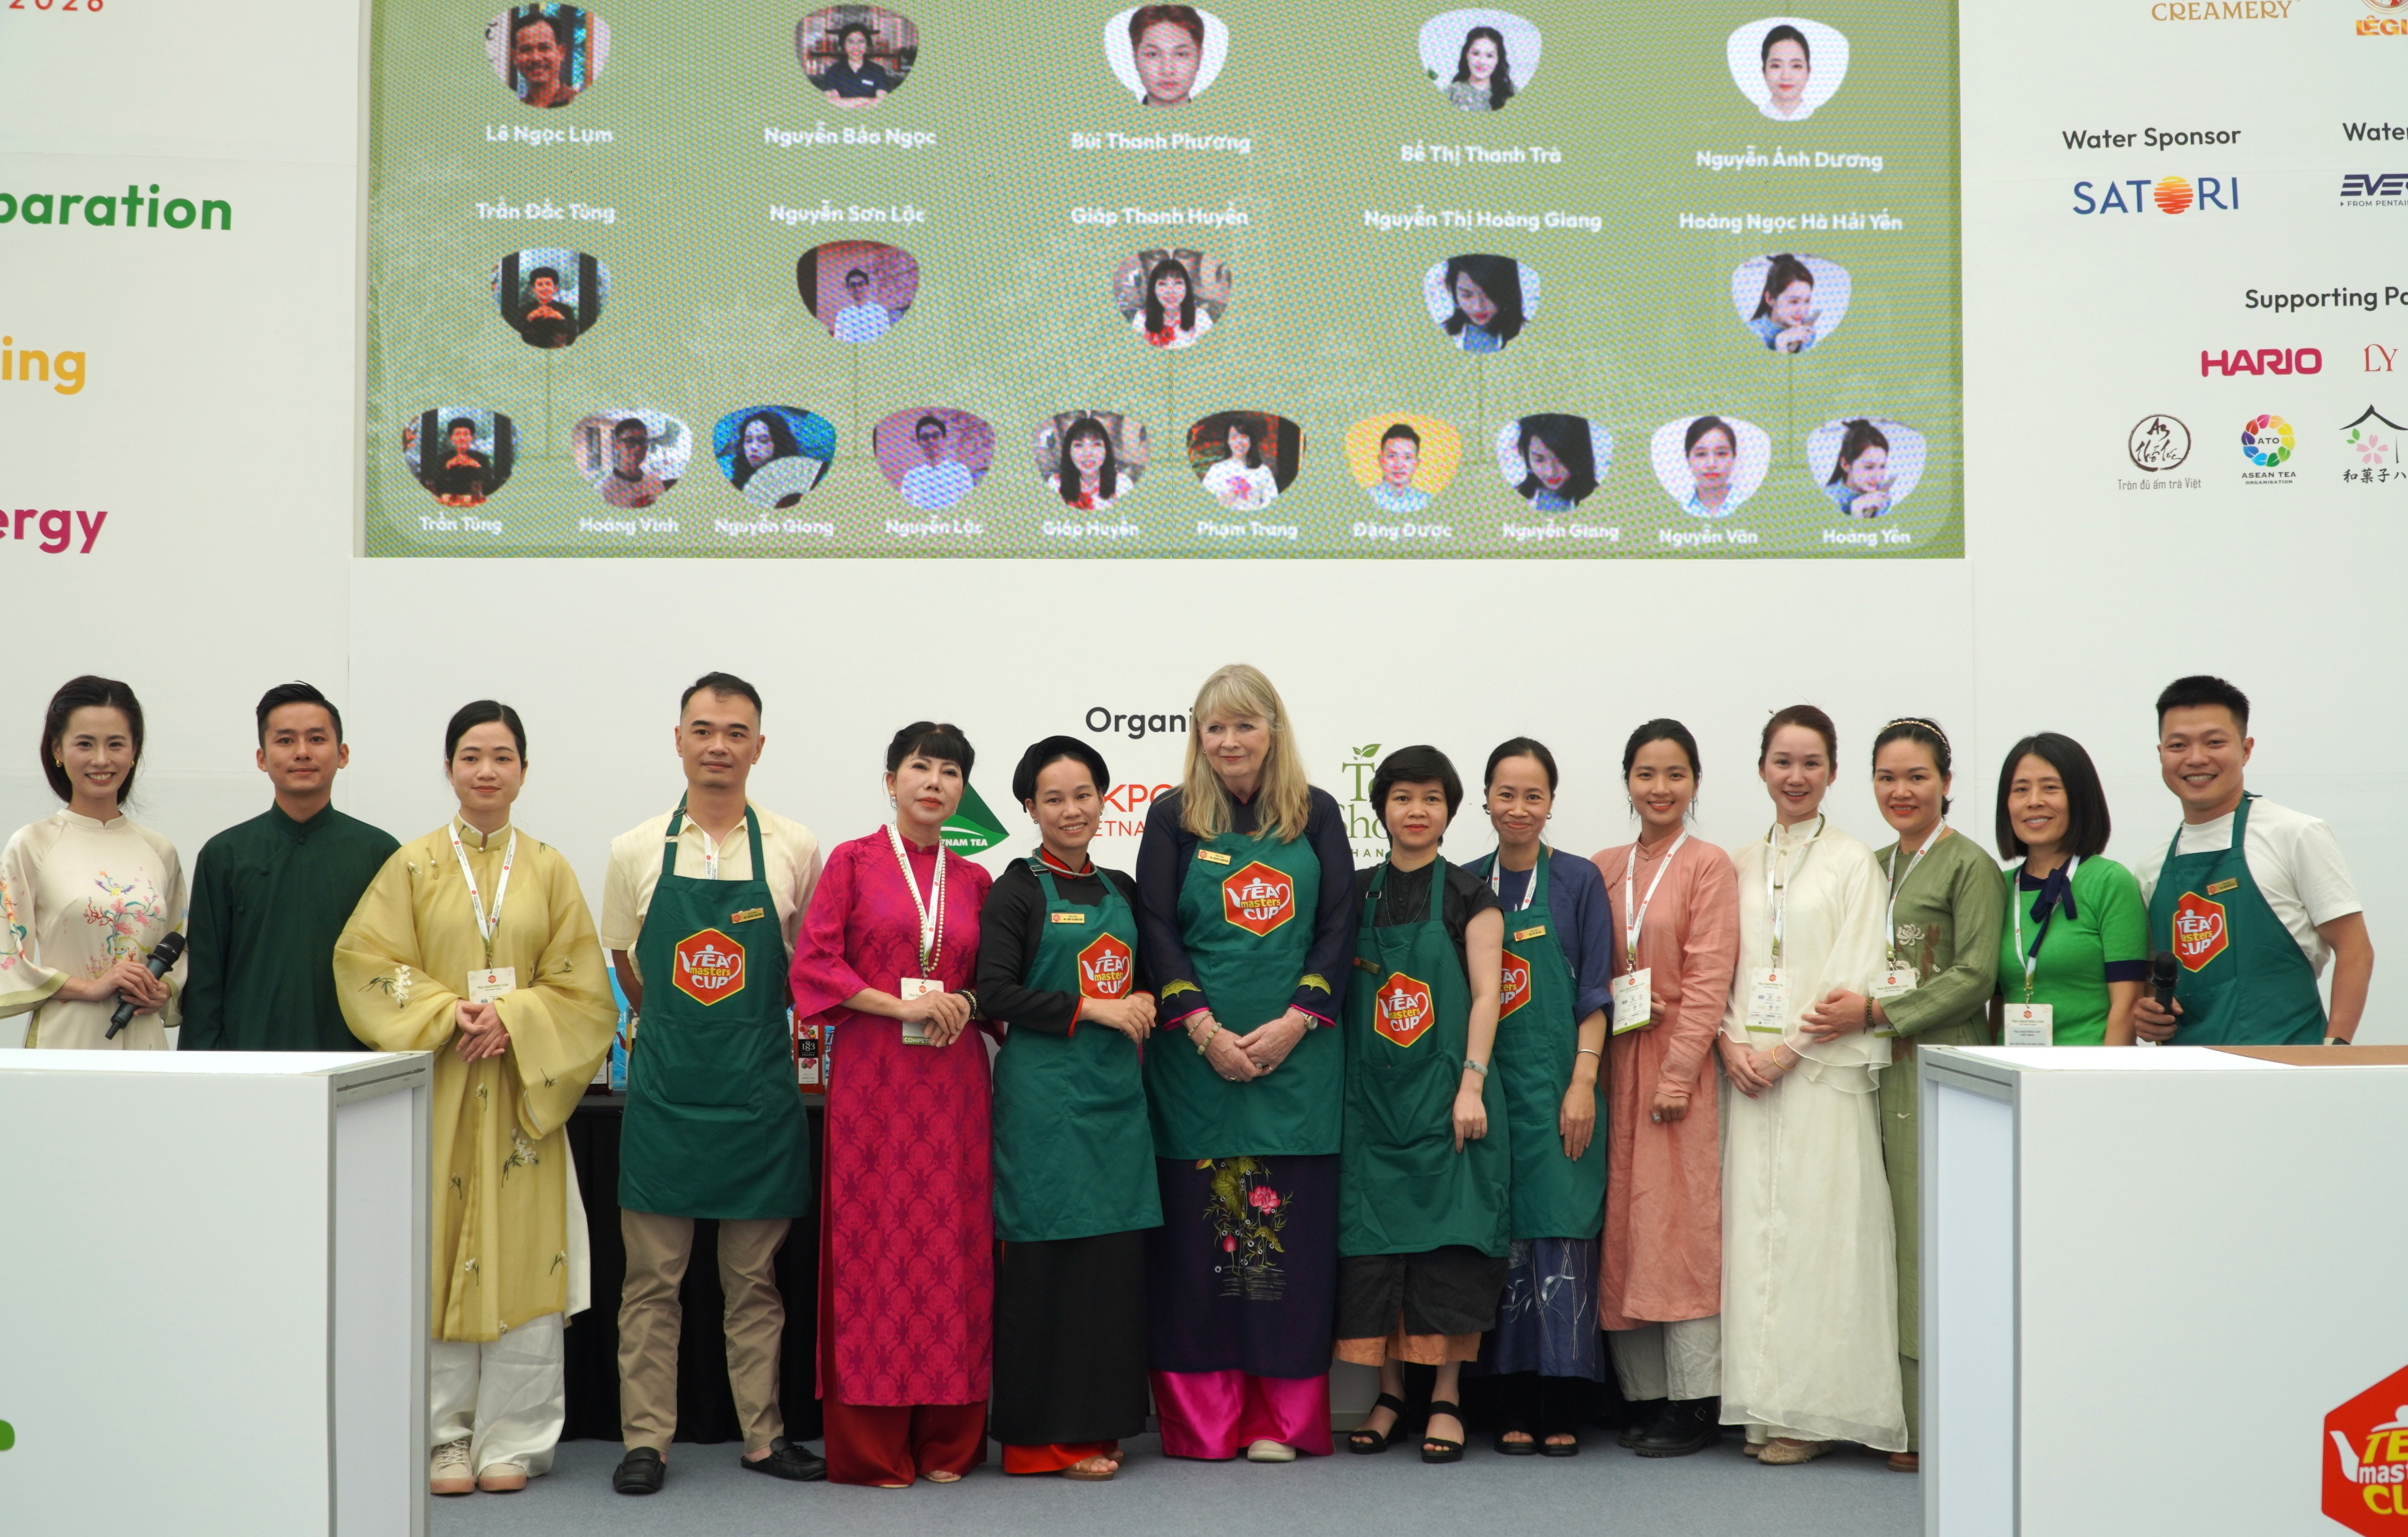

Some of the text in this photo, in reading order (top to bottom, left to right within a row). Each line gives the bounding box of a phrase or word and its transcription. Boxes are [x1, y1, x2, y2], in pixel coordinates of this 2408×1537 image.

[2152, 0, 2292, 21] CREAMERY
[486, 124, 508, 141] Lê
[514, 126, 565, 146] Ngọc
[765, 122, 838, 147] Nguyễn
[885, 127, 936, 148] Ngọc
[2062, 127, 2241, 151] Water Sponsor
[2342, 122, 2408, 141] Wate
[1107, 132, 1167, 150] Thanh
[1172, 133, 1251, 154] Phương
[1430, 146, 1460, 167] Thị
[1465, 146, 1525, 164] Thanh
[1696, 145, 1883, 172] Nguyễn Ánh Dương
[2073, 176, 2239, 215] SATORI
[2340, 174, 2408, 196] EVE
[476, 196, 520, 219] Trần
[569, 203, 616, 224] Tùng
[770, 200, 843, 225] Nguyễn
[1124, 207, 1183, 224] Thanh
[1365, 204, 1602, 232] Nguyễn Thị Hoàng Giang
[1680, 208, 1902, 234] Hoàng Ngọc Hà Hải Yến
[2245, 287, 2378, 313] Supporting
[2201, 348, 2322, 377] HARIO
[2117, 477, 2201, 490] Tròn đủ ấm trà Việt
[1342, 762, 1376, 801] T
[1241, 898, 1280, 908] masters
[1242, 886, 1279, 900] TEA
[1244, 906, 1279, 920] CUP
[2182, 930, 2212, 942] asters
[690, 967, 731, 976] masters
[691, 954, 729, 968] TEA
[1095, 959, 1123, 973] TEA
[691, 975, 729, 989] CUP
[1094, 971, 1123, 981] master
[1389, 997, 1418, 1011] TEA
[1391, 1016, 1420, 1032] CUP
